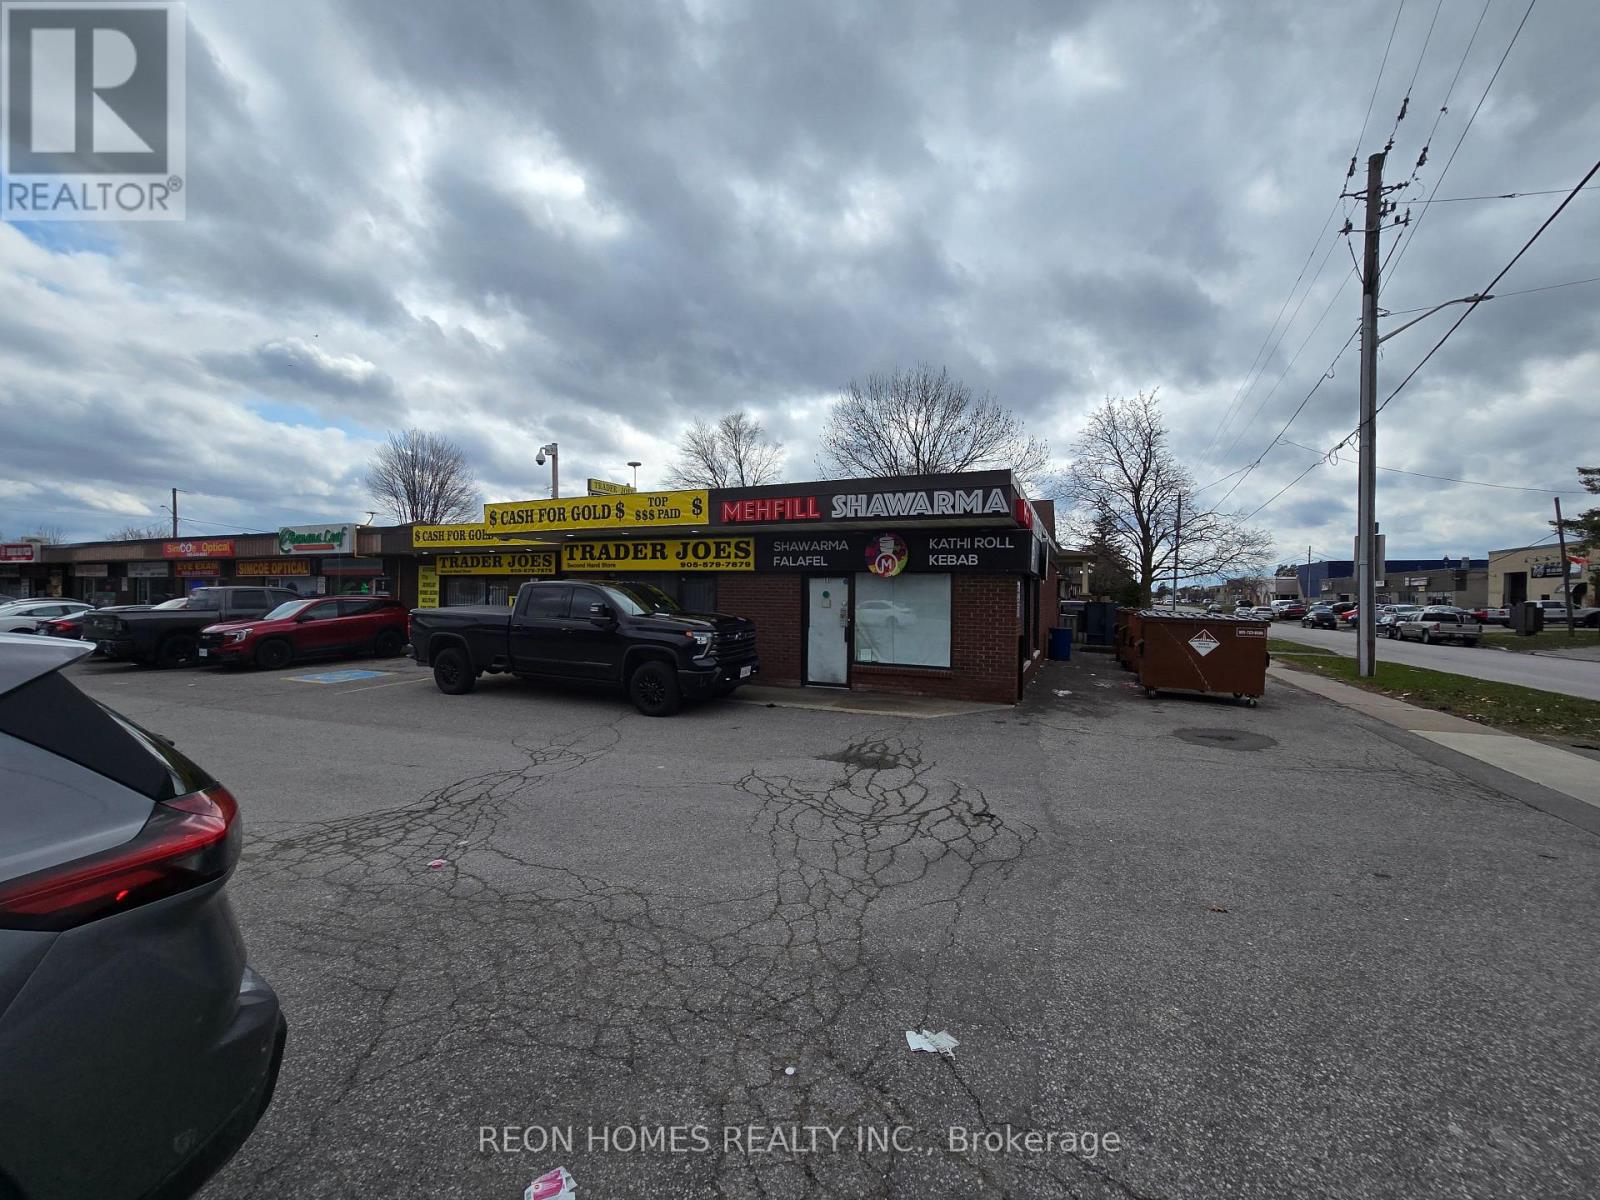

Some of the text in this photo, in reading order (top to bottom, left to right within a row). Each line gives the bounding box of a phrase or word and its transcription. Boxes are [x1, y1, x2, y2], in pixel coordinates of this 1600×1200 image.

[647, 496, 669, 508] TOP
[720, 496, 821, 523] MEHFILL
[831, 487, 1010, 519] SHAWARMA
[500, 508, 535, 526] CASH
[537, 506, 567, 523] FOR
[570, 503, 611, 522] GOLD
[635, 507, 681, 521] $$$ PAID
[422, 530, 445, 542] CASH
[447, 529, 466, 541] FOR
[201, 541, 230, 554] Optical
[773, 540, 849, 551] SHAWARMA
[929, 537, 1014, 550] KATHI ROLL
[564, 540, 752, 561] TRADER JOES
[440, 554, 553, 568] TRADER JOES
[773, 555, 828, 567] FALAFEL
[929, 554, 978, 566] KEBAB
[239, 560, 309, 574] SIMCOE OPTICAL
